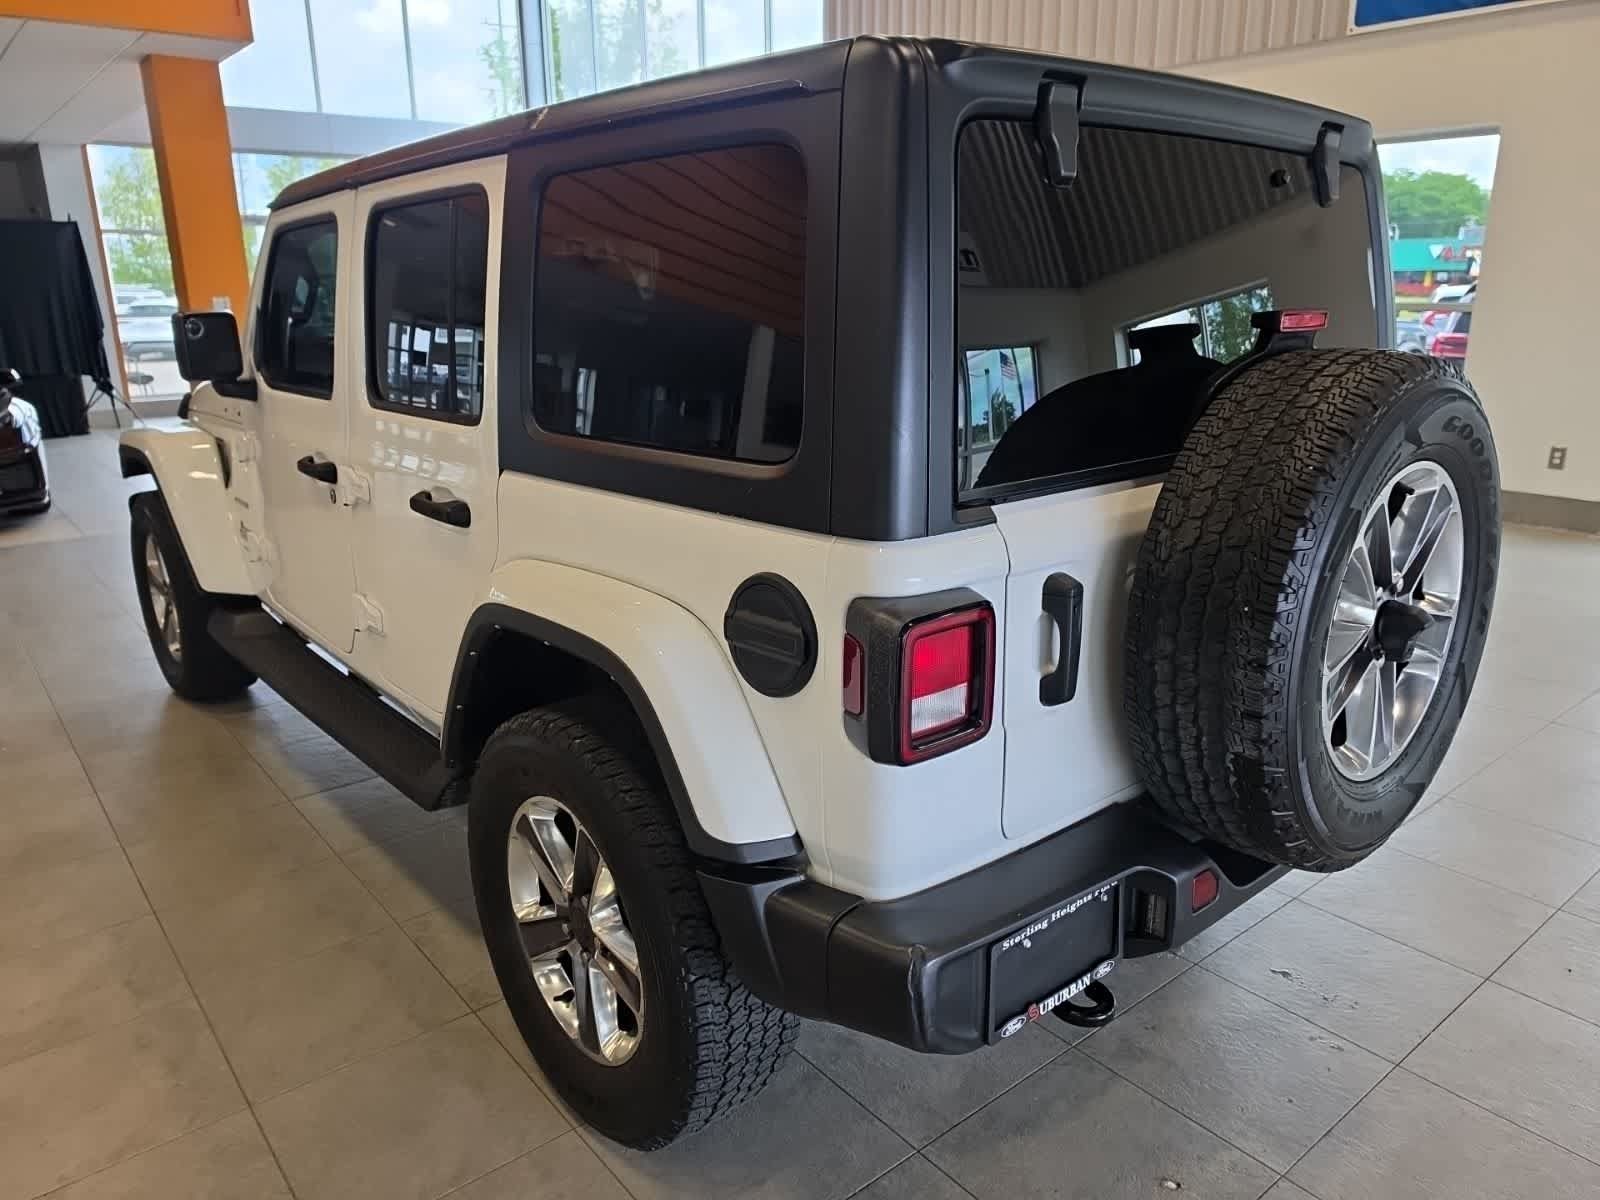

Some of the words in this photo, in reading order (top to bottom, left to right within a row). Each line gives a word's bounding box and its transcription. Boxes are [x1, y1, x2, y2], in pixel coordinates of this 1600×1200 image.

[1002, 919, 1049, 951] Sterling
[1051, 893, 1093, 922] Heights
[1028, 973, 1091, 1022] SUBURBAN
